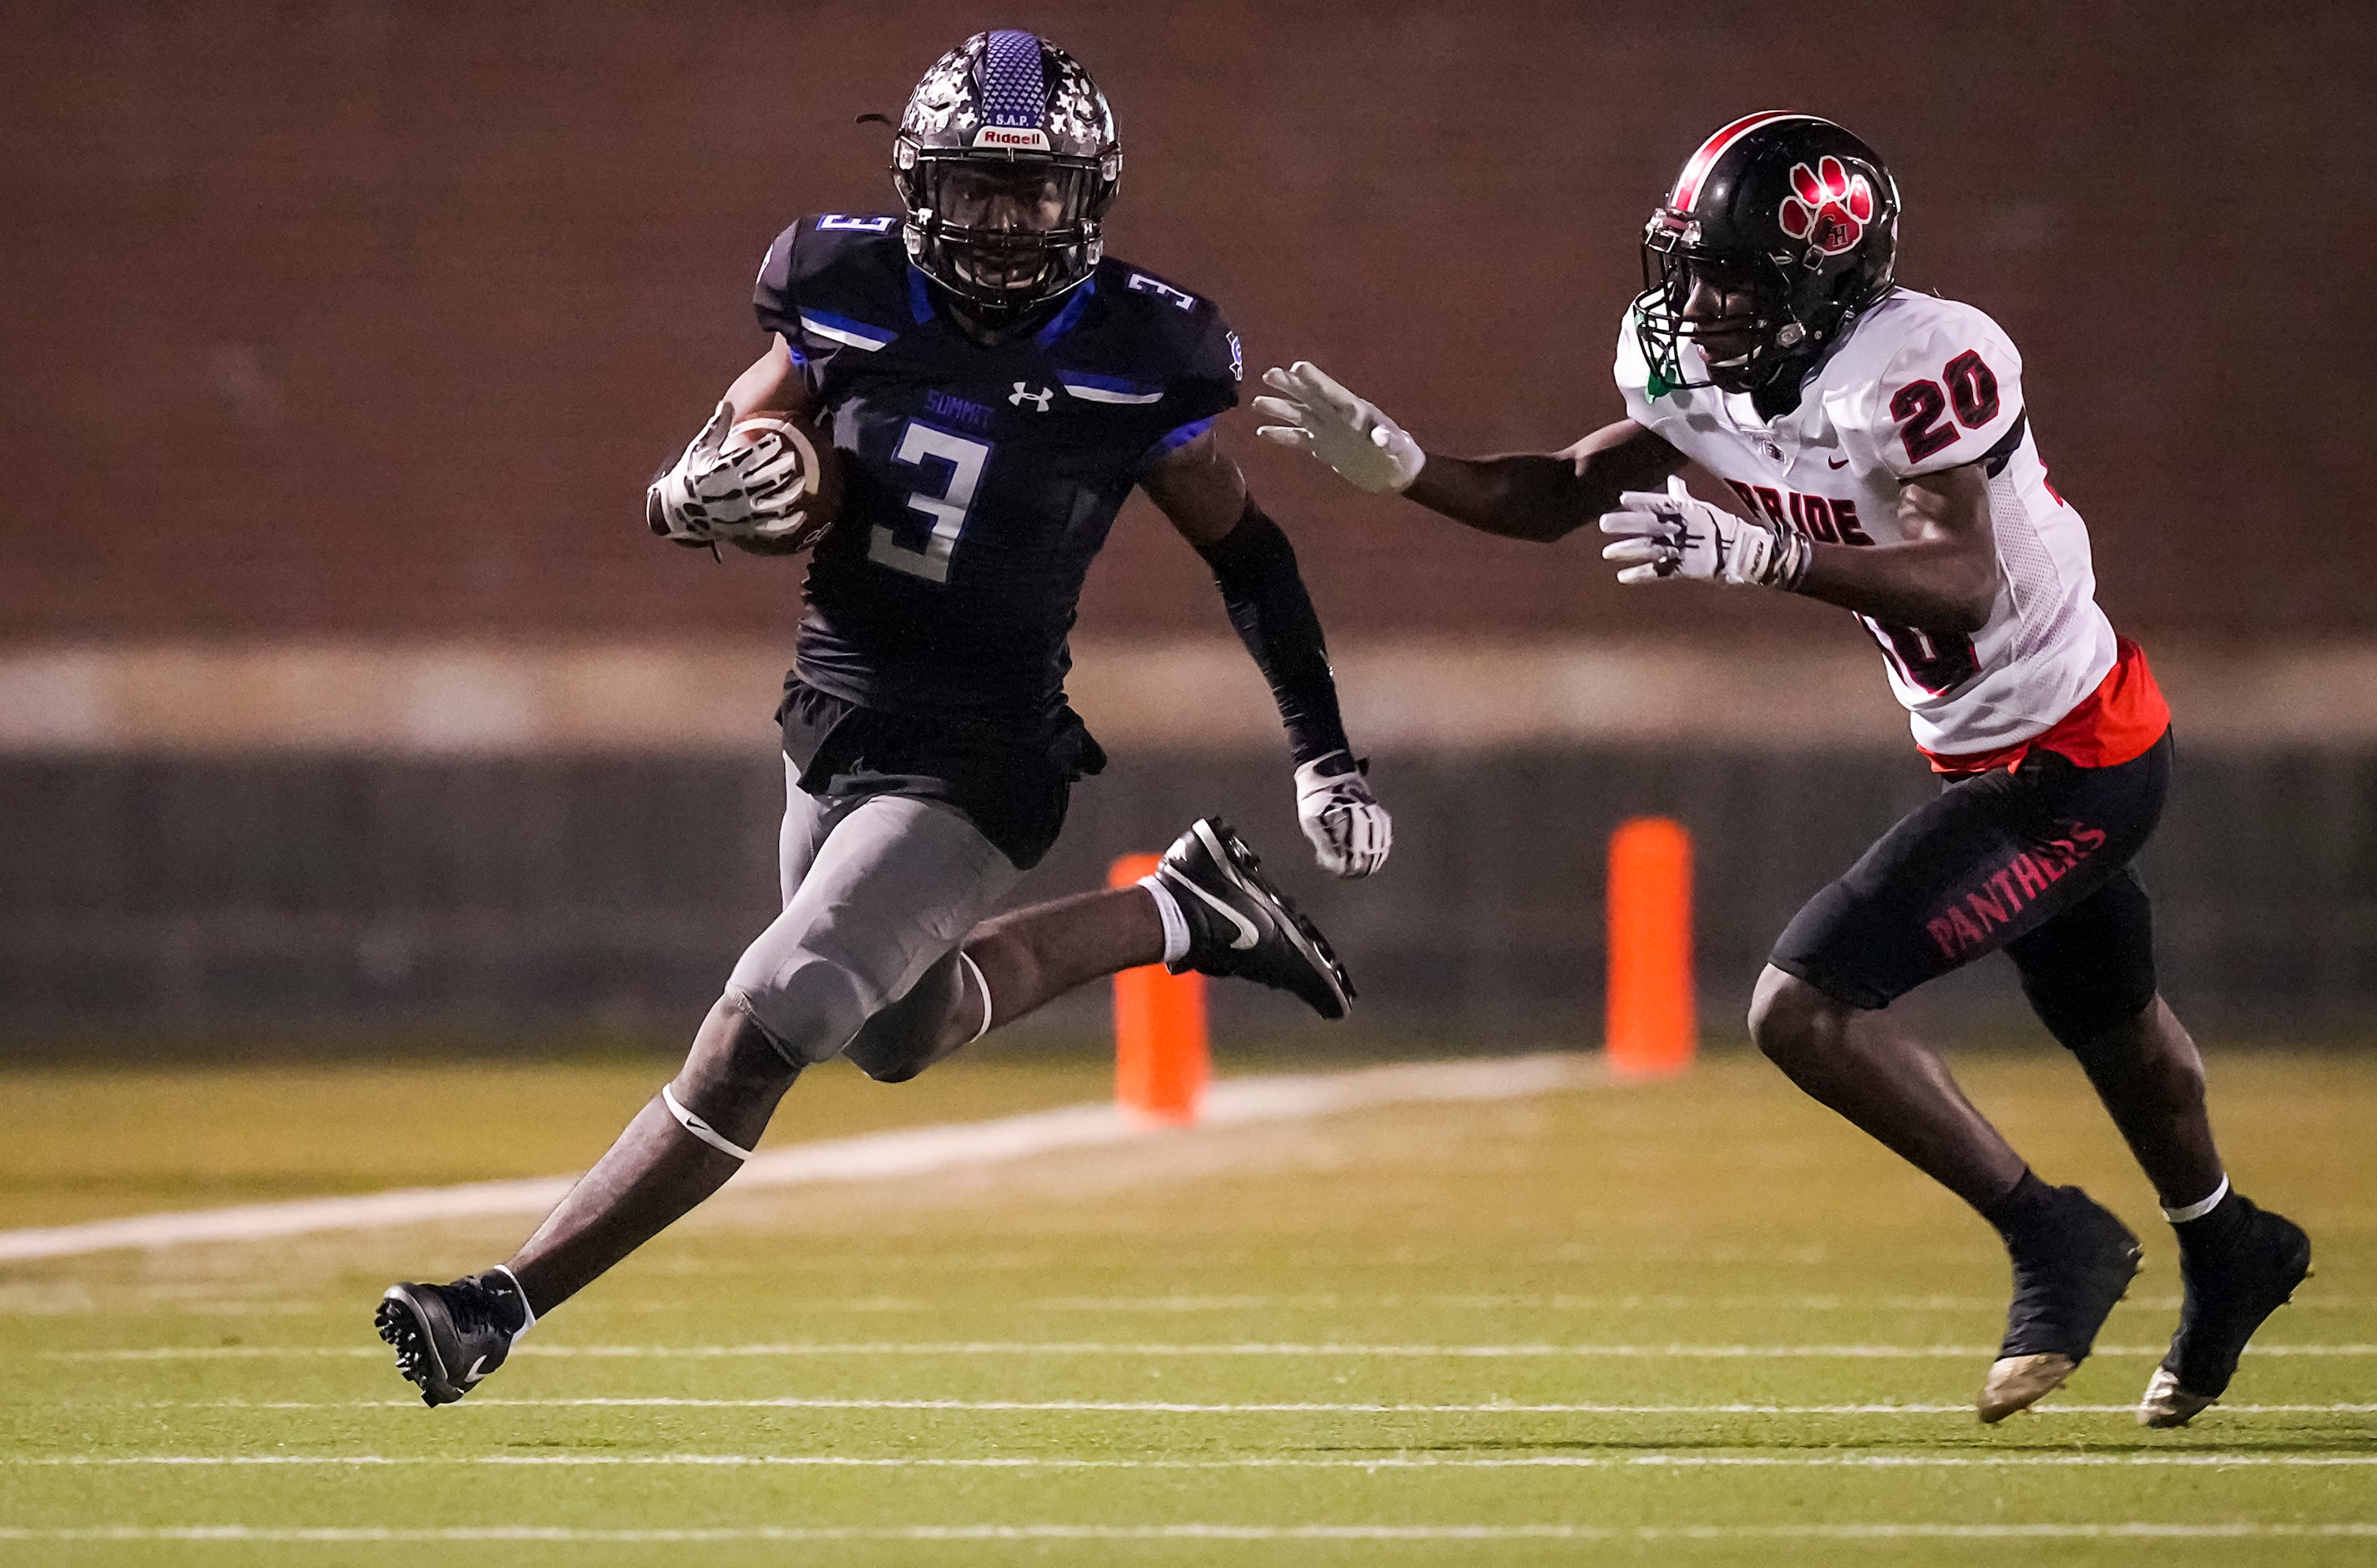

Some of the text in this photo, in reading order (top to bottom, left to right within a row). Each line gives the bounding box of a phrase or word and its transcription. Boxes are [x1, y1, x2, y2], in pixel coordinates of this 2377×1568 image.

[984, 131, 1040, 144] Riddell
[1889, 349, 2000, 463] 20
[867, 421, 994, 584] 3
